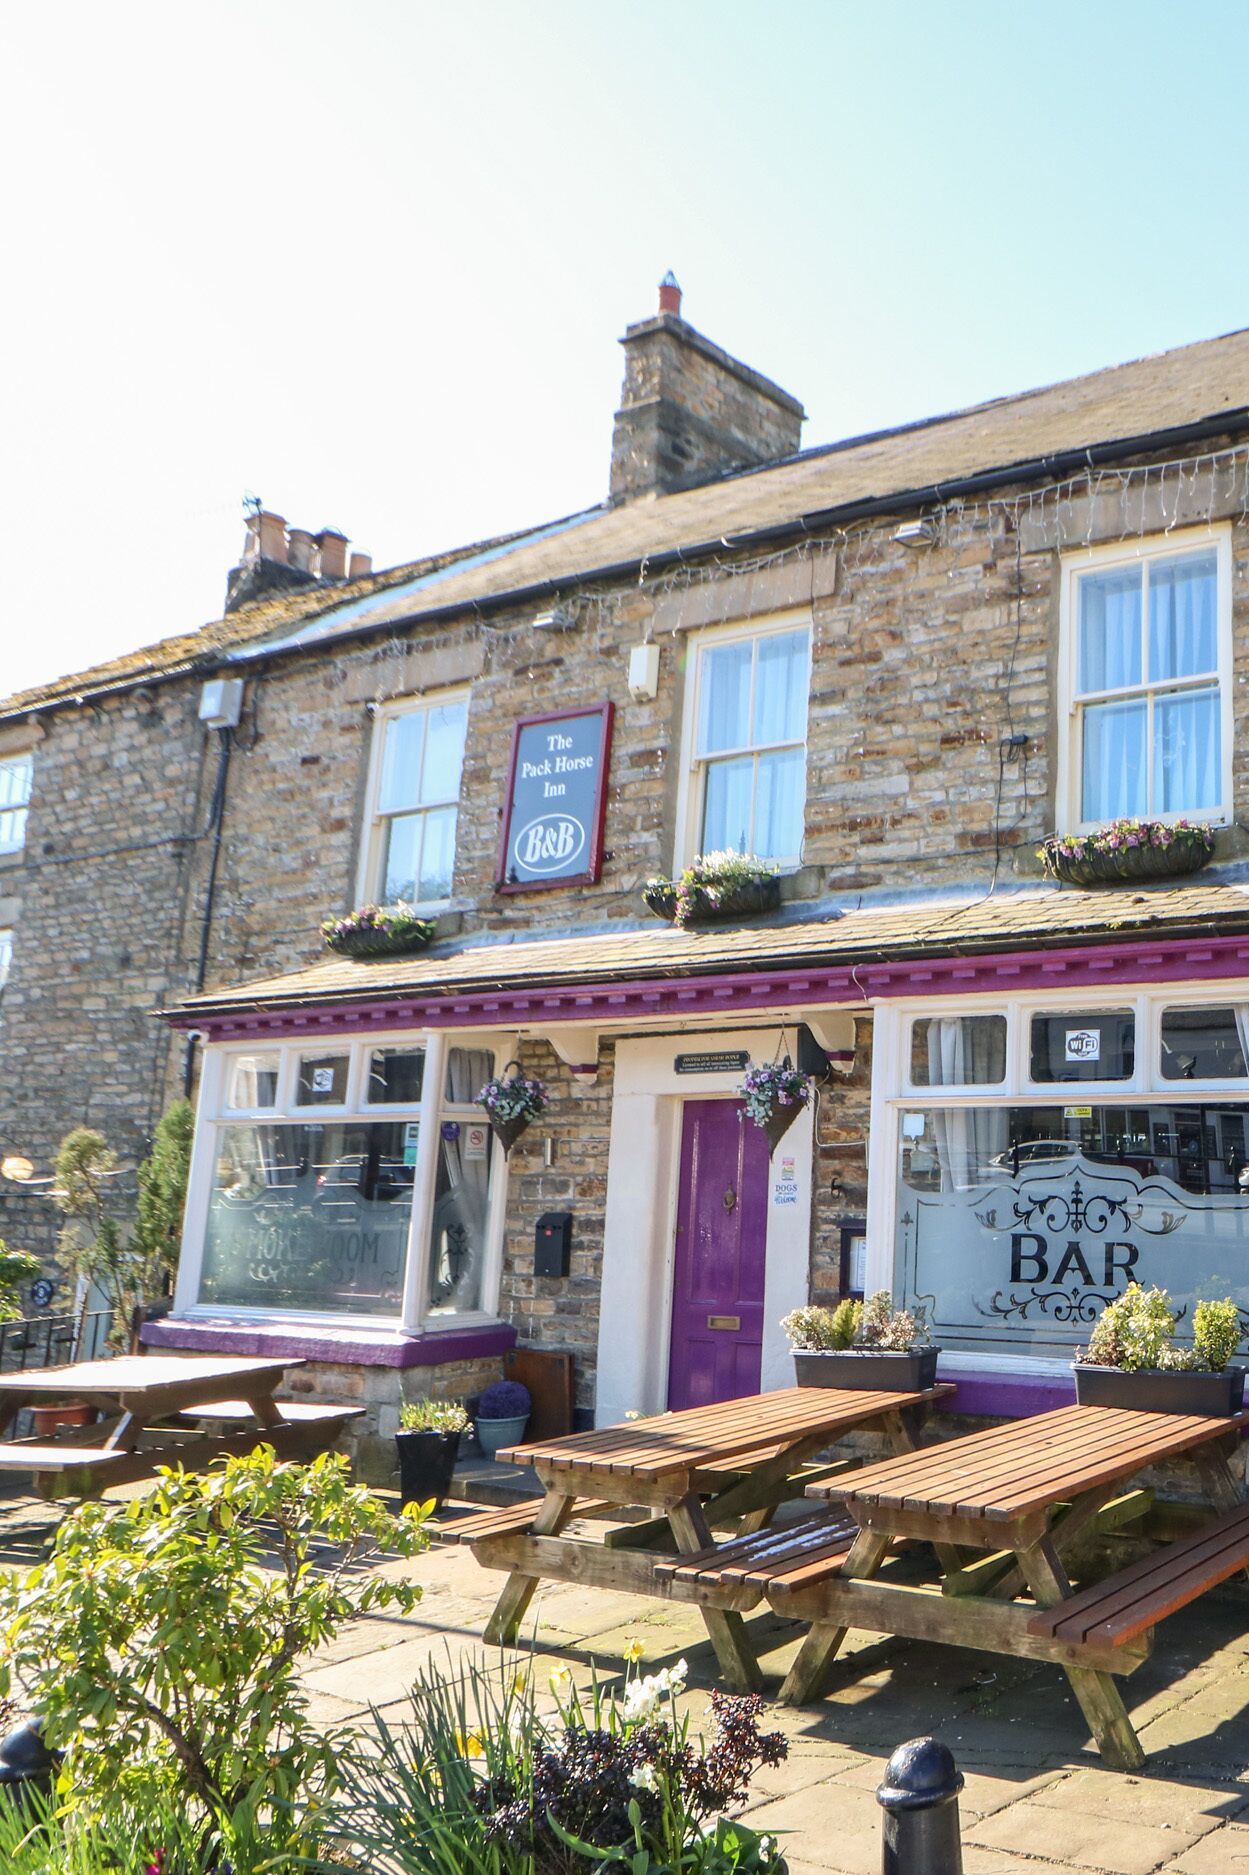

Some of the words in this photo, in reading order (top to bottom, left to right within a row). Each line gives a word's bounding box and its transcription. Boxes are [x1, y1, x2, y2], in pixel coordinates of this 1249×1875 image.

[547, 734, 573, 752] The
[521, 760, 552, 779] Pack
[554, 755, 594, 774] Horse
[543, 781, 566, 798] Inn
[523, 821, 575, 863] B&B
[775, 1184, 798, 1192] DOGS
[1009, 1233, 1146, 1286] BAR
